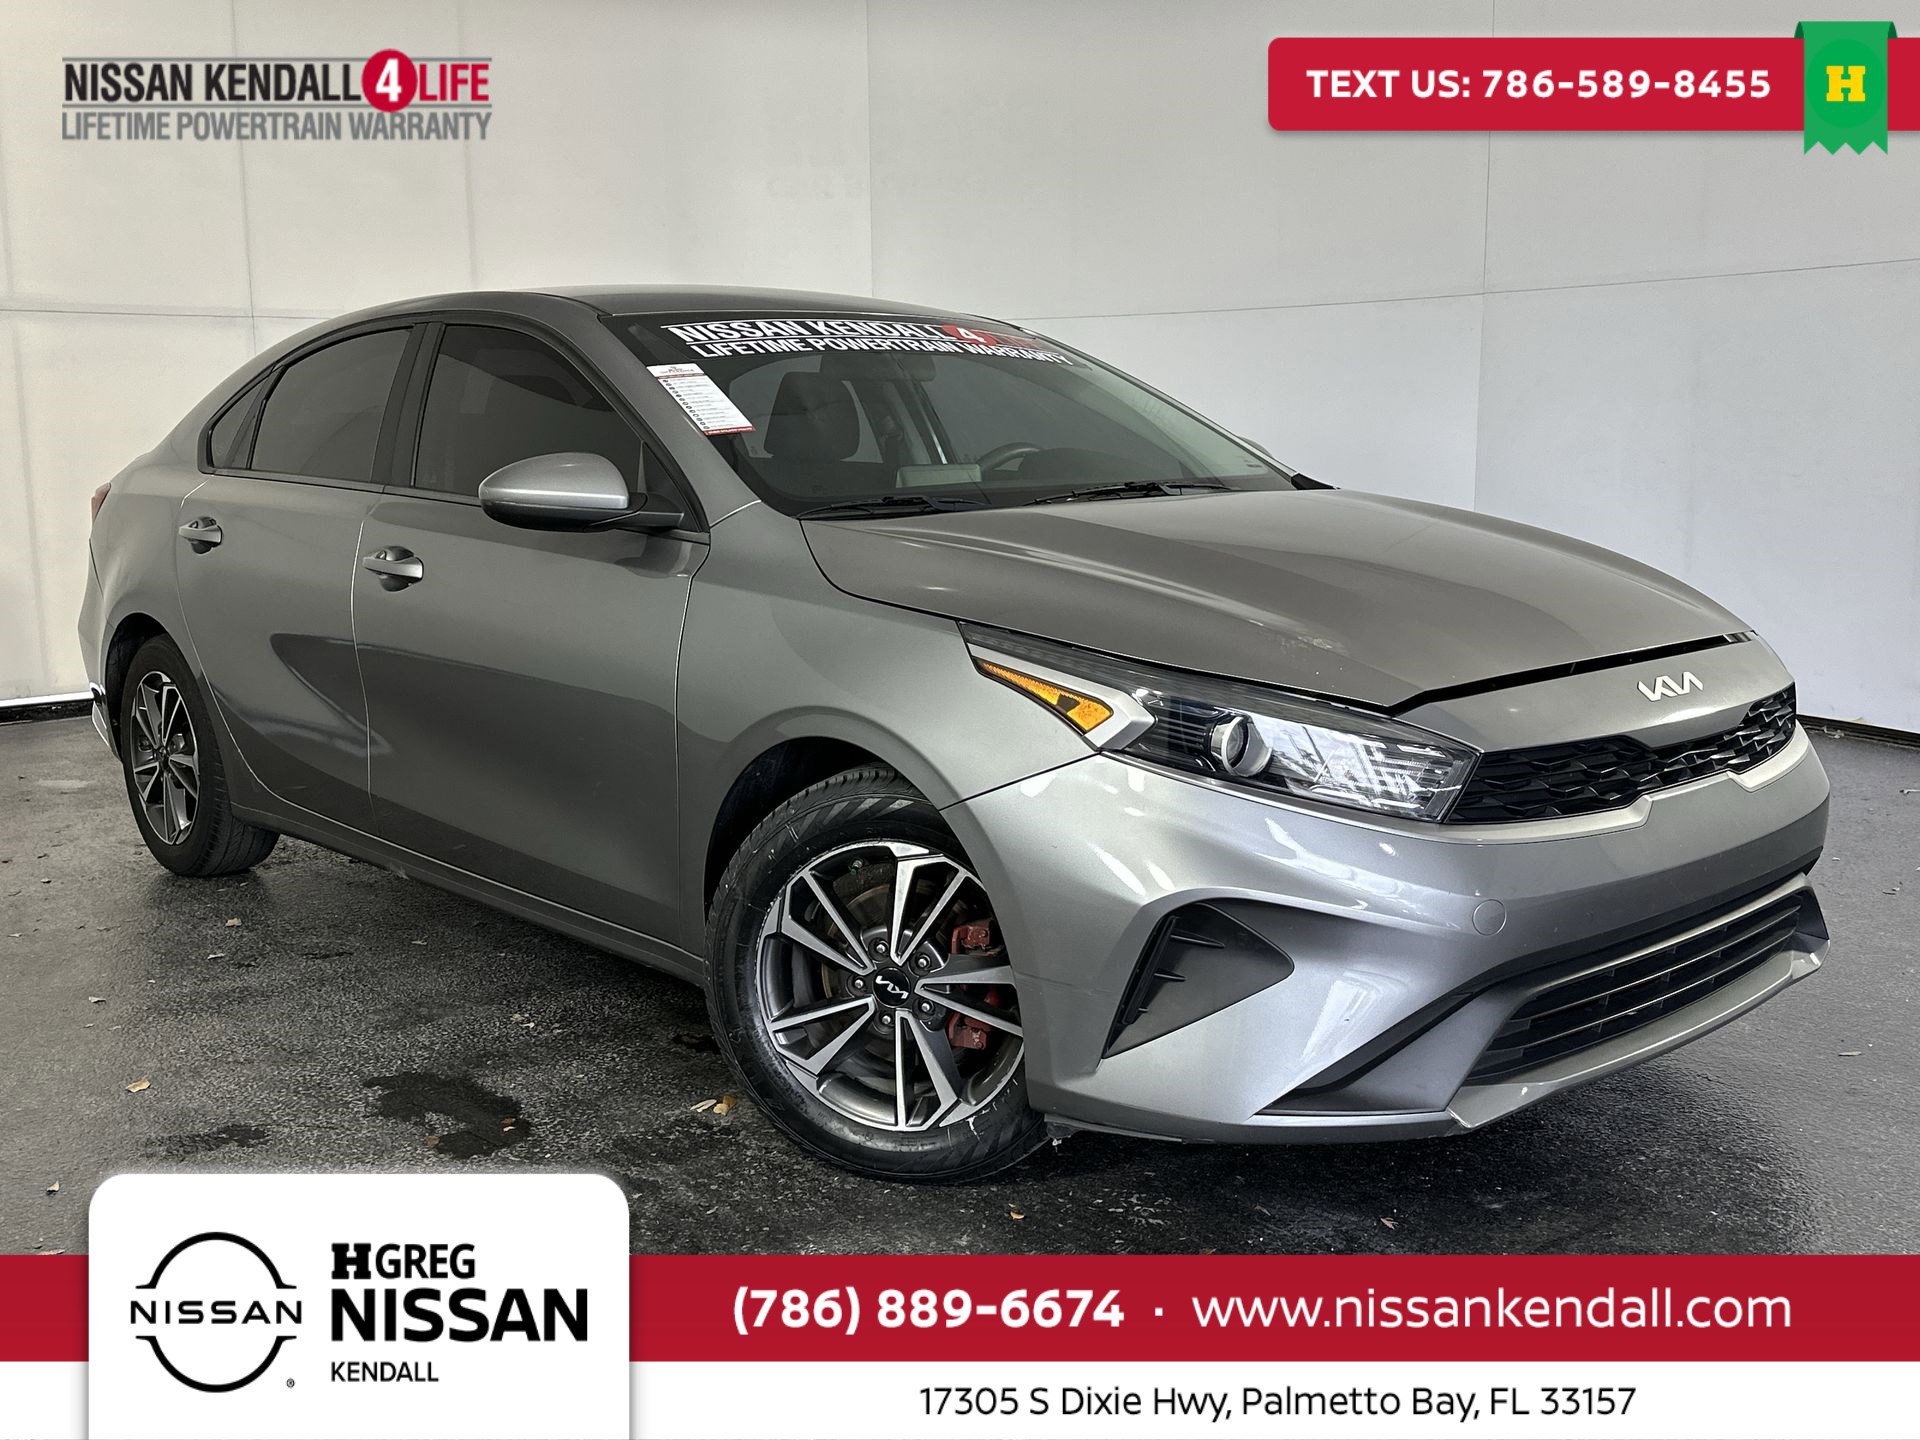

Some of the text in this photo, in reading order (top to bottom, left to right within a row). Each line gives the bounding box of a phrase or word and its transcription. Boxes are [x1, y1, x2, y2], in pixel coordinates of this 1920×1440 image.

[667, 320, 812, 343] NISSAN
[805, 320, 950, 340] KENDALL
[690, 338, 813, 358] LIFETIME
[805, 338, 963, 353] POWERTRAIN
[958, 342, 1073, 366] WARRANTY
[1637, 671, 1703, 702] KIA
